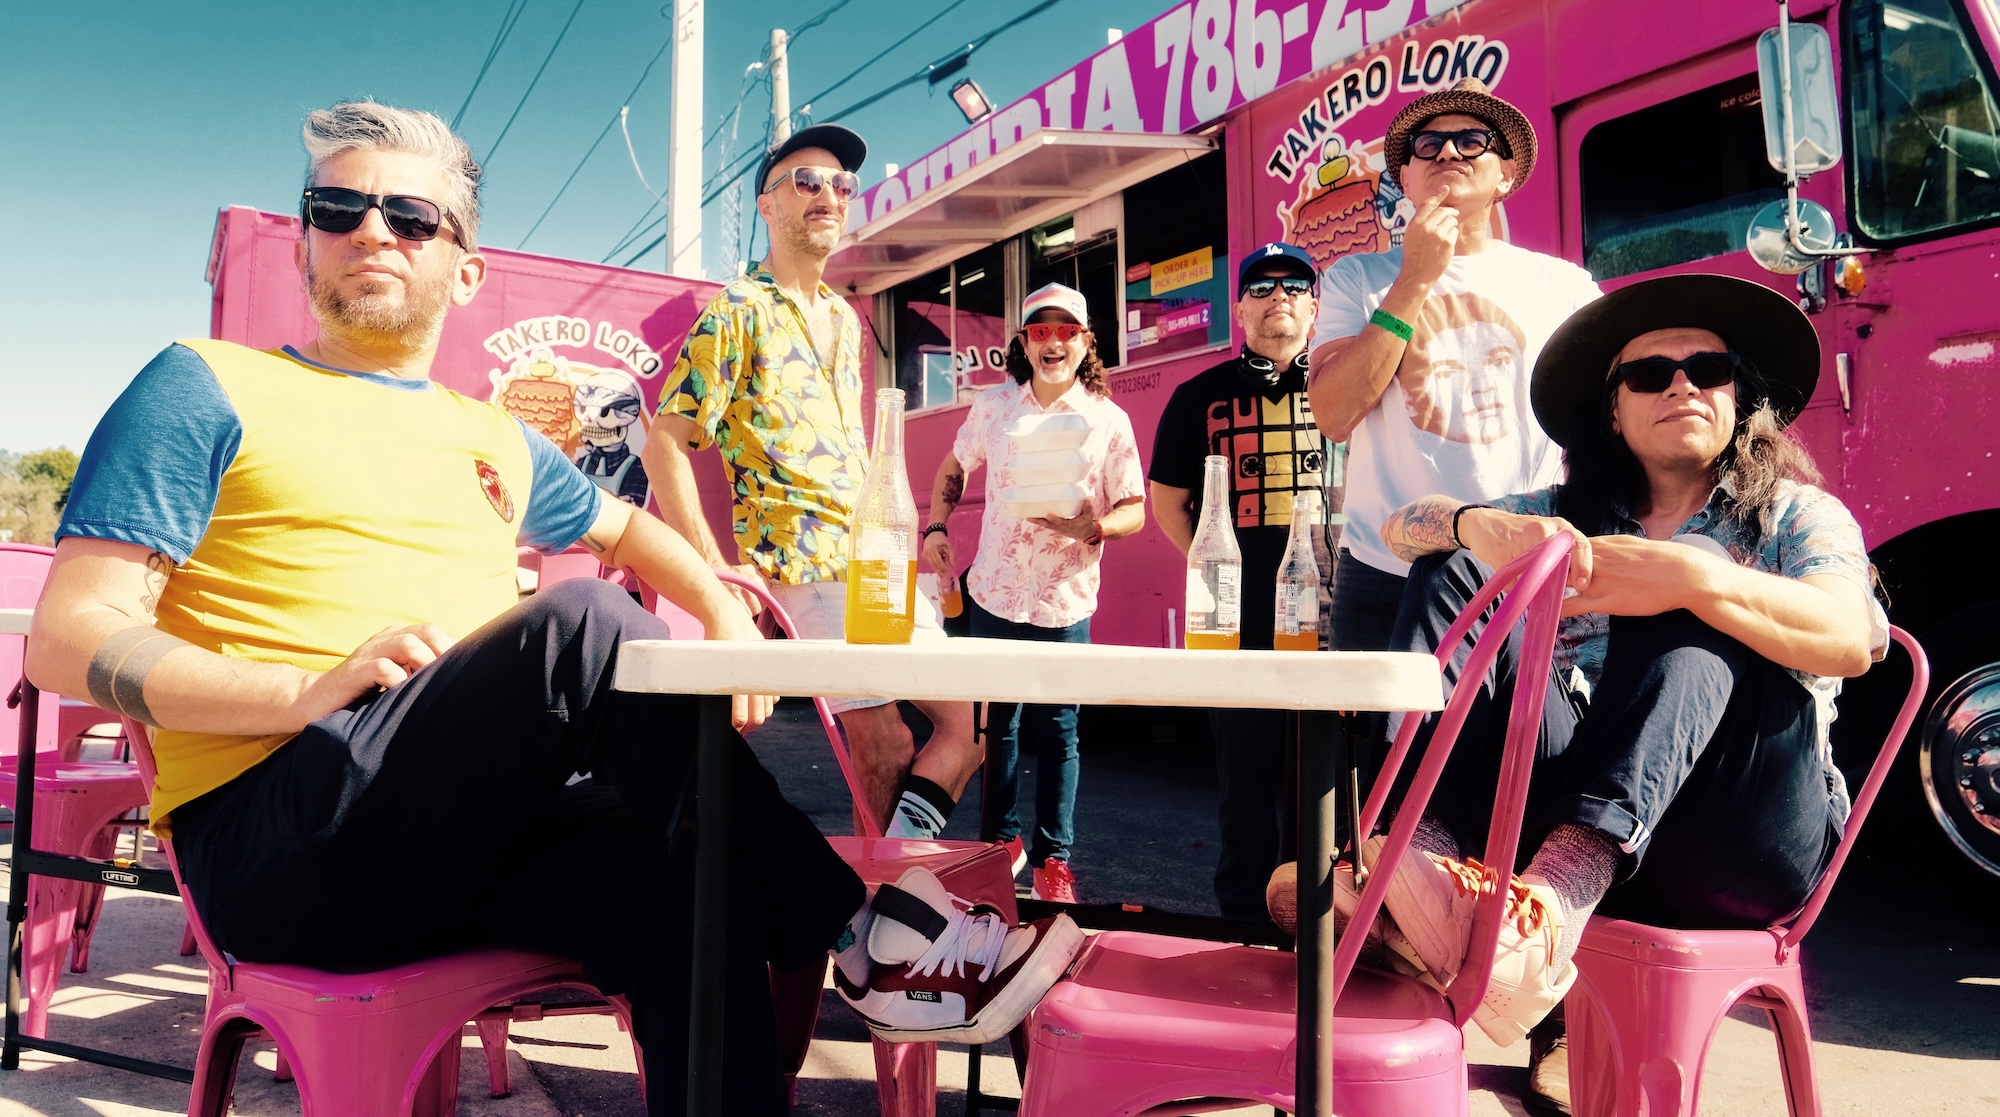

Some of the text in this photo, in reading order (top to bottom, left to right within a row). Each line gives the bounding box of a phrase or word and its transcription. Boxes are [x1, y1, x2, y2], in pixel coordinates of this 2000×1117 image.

[1267, 40, 1504, 179] TAKERO LOKO
[1154, 271, 1187, 290] PICK-UP
[1189, 264, 1209, 280] HERE
[1163, 259, 1189, 276] ORDER
[1191, 256, 1199, 266] &
[489, 319, 660, 376] TAKERO LOKO
[1110, 372, 1161, 395] MFD2360437
[105, 872, 135, 883] LIFETIME
[910, 990, 933, 1001] VANS
